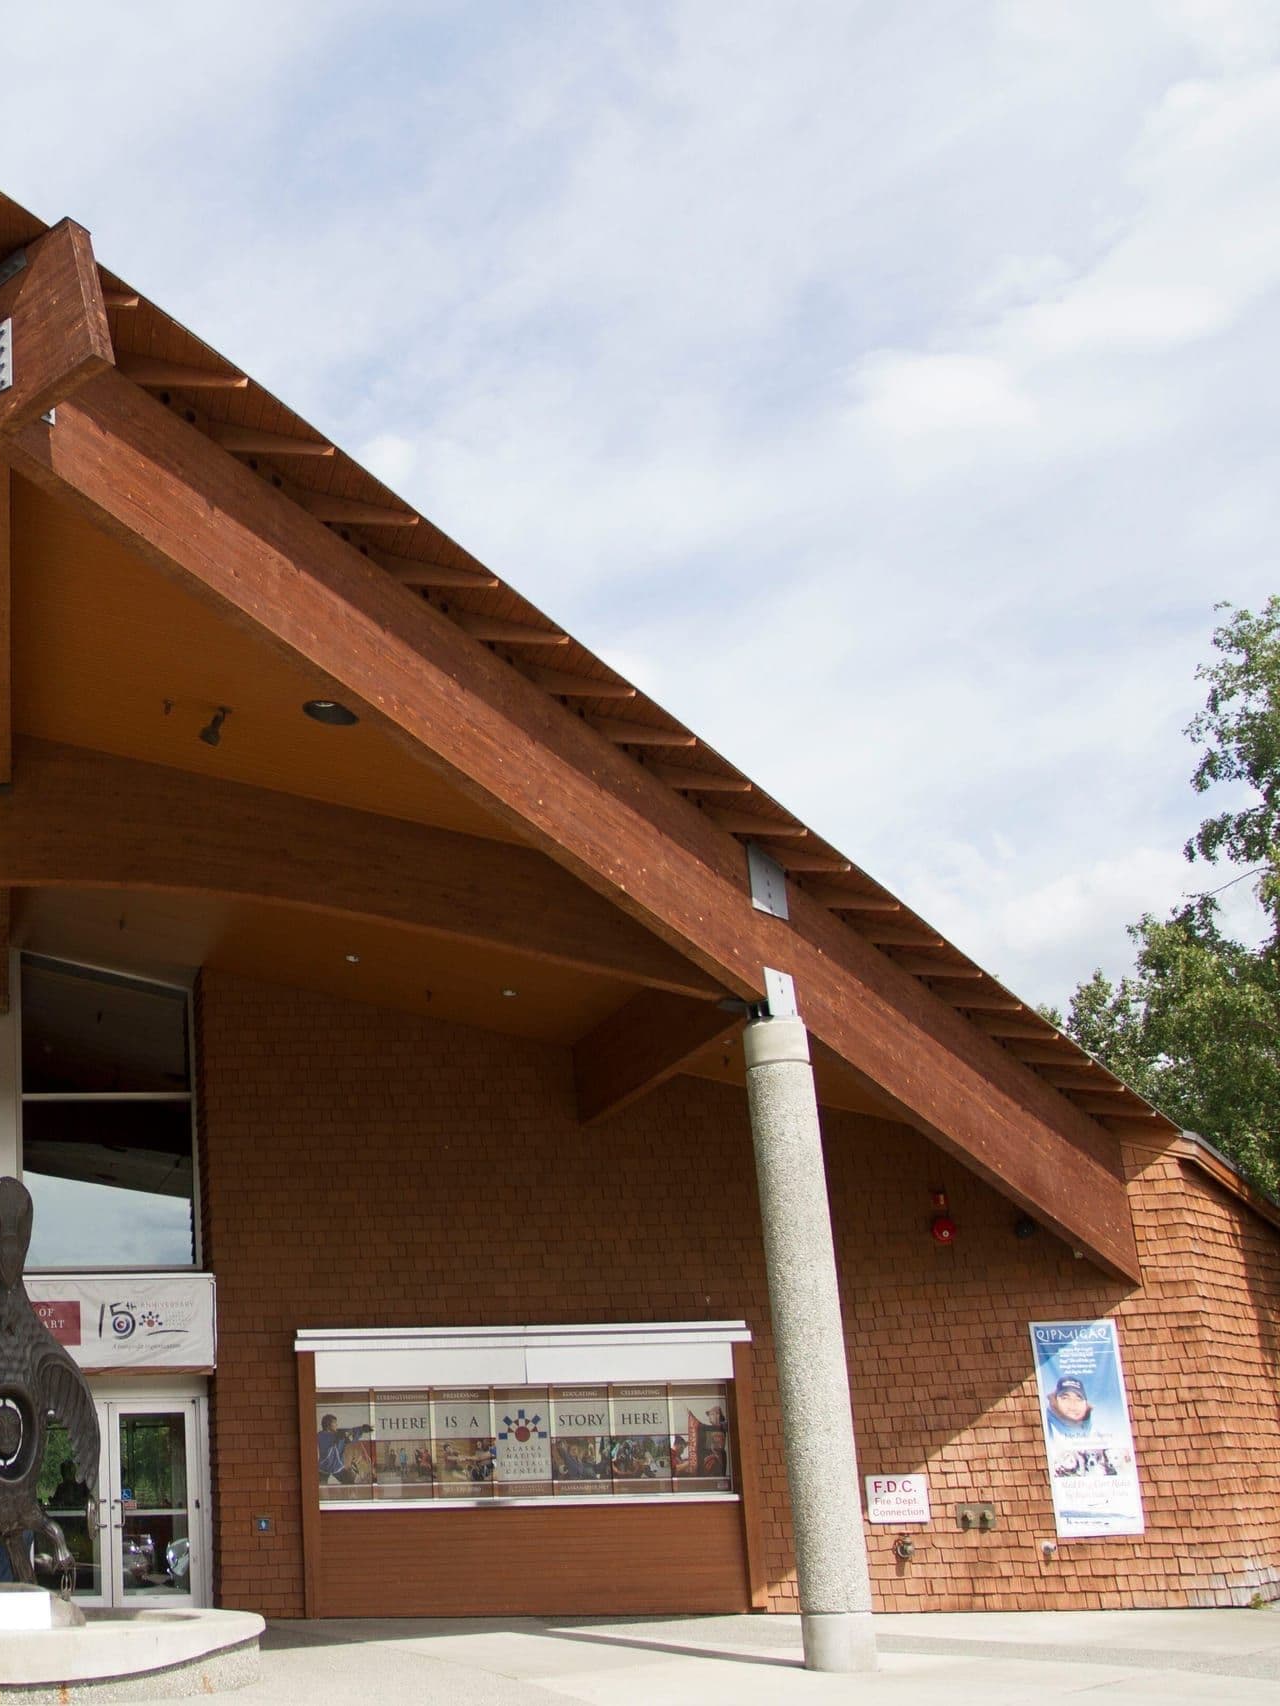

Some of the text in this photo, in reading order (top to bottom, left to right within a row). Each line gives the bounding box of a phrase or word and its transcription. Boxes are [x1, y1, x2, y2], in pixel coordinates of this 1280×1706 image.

[39, 1308, 54, 1317] OF
[379, 1412, 663, 1430] THERE IS A STORY HERE.
[873, 1480, 917, 1493] F.D.C.
[875, 1497, 891, 1505] Fire
[872, 1508, 925, 1516] Connection
